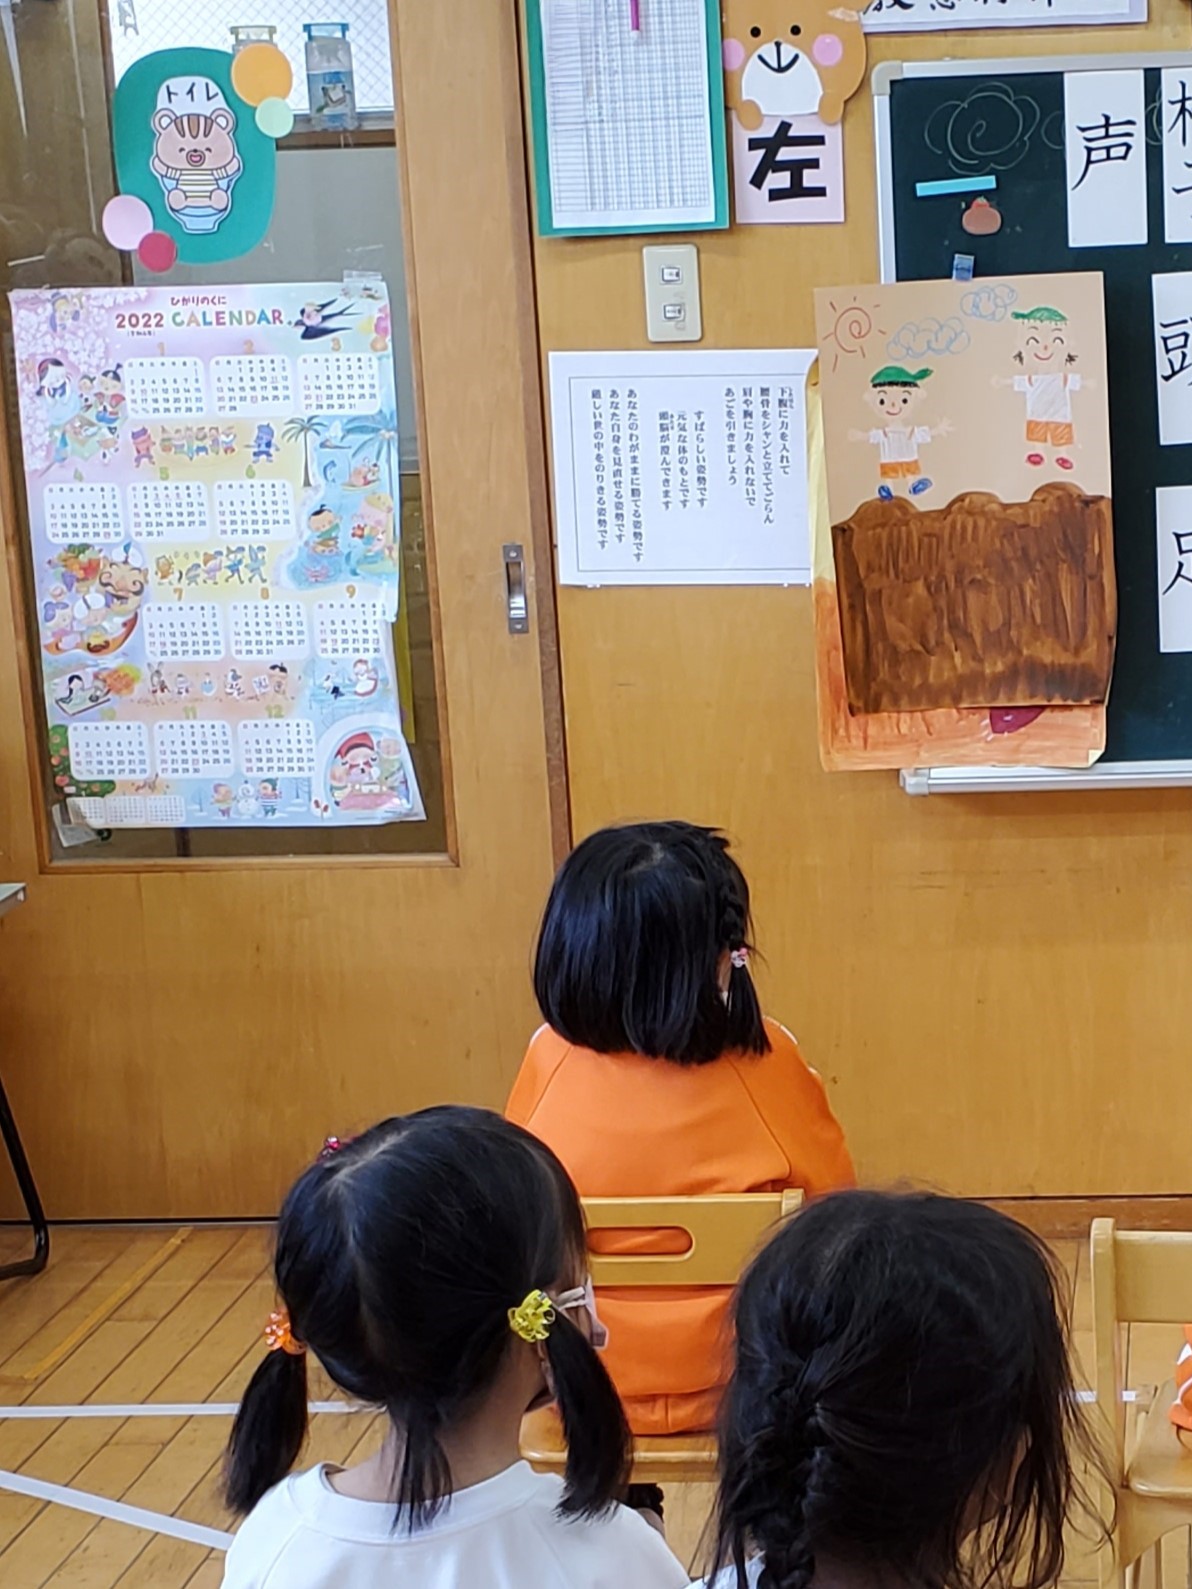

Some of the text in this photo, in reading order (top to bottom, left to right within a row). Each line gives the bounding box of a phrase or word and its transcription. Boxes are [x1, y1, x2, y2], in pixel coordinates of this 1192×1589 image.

[166, 81, 219, 104] トイレ
[1072, 113, 1137, 190] 声
[747, 120, 827, 202] 左
[170, 295, 227, 307] ひかりのくに
[115, 308, 284, 329] 2022 CALENDAR
[331, 337, 341, 351] 3
[160, 466, 169, 481] 5
[246, 464, 256, 479] 6
[173, 588, 183, 601] 7
[346, 585, 356, 598] 9
[183, 706, 197, 720] 11
[266, 705, 285, 719] 12
